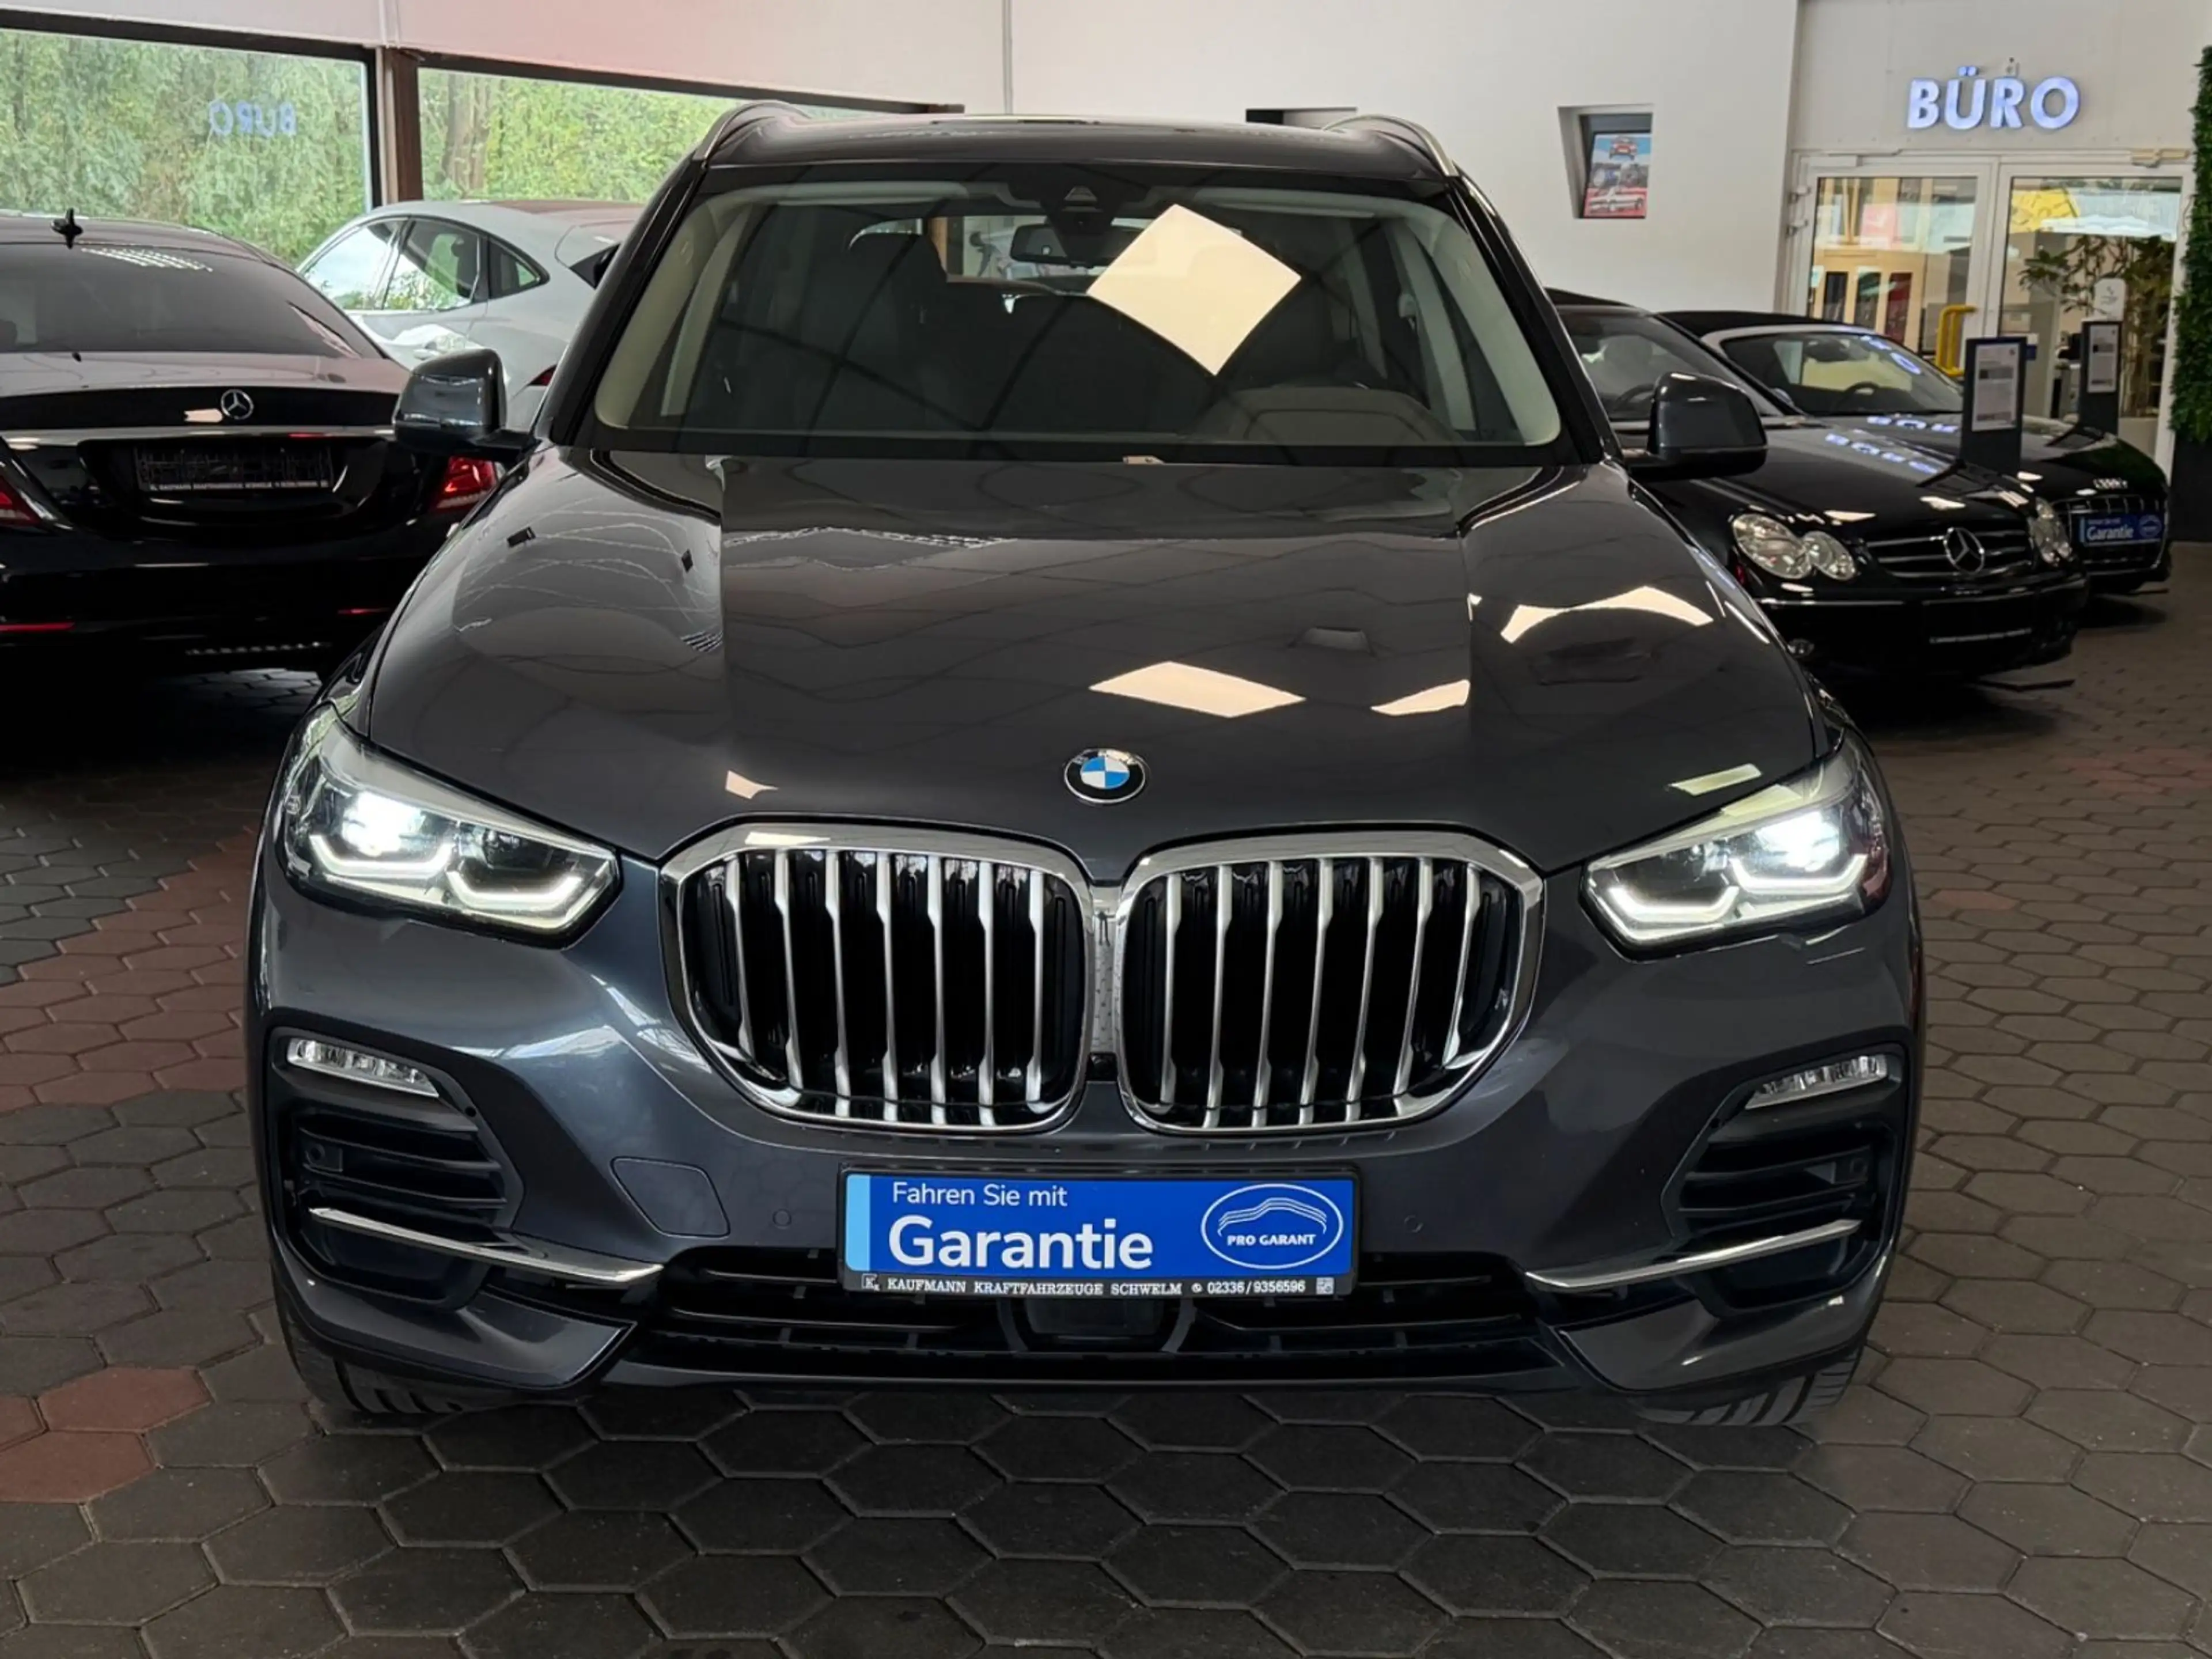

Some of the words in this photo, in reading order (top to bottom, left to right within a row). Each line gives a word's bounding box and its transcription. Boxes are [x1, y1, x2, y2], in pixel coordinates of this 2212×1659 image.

[1907, 66, 2080, 130] BÜRO
[892, 1181, 975, 1205] Fahren
[983, 1184, 1020, 1206] Sie
[1028, 1185, 1068, 1207] mit
[888, 1214, 1154, 1269] Garantie
[1227, 1235, 1256, 1246] PRO
[1259, 1234, 1316, 1246] GARANT
[887, 1278, 967, 1293] KAUFMANN
[974, 1281, 1104, 1296] KRAFTFAHRZEUGE
[1110, 1282, 1183, 1296] SCHWELM
[1207, 1280, 1306, 1294] 02336/9356596
